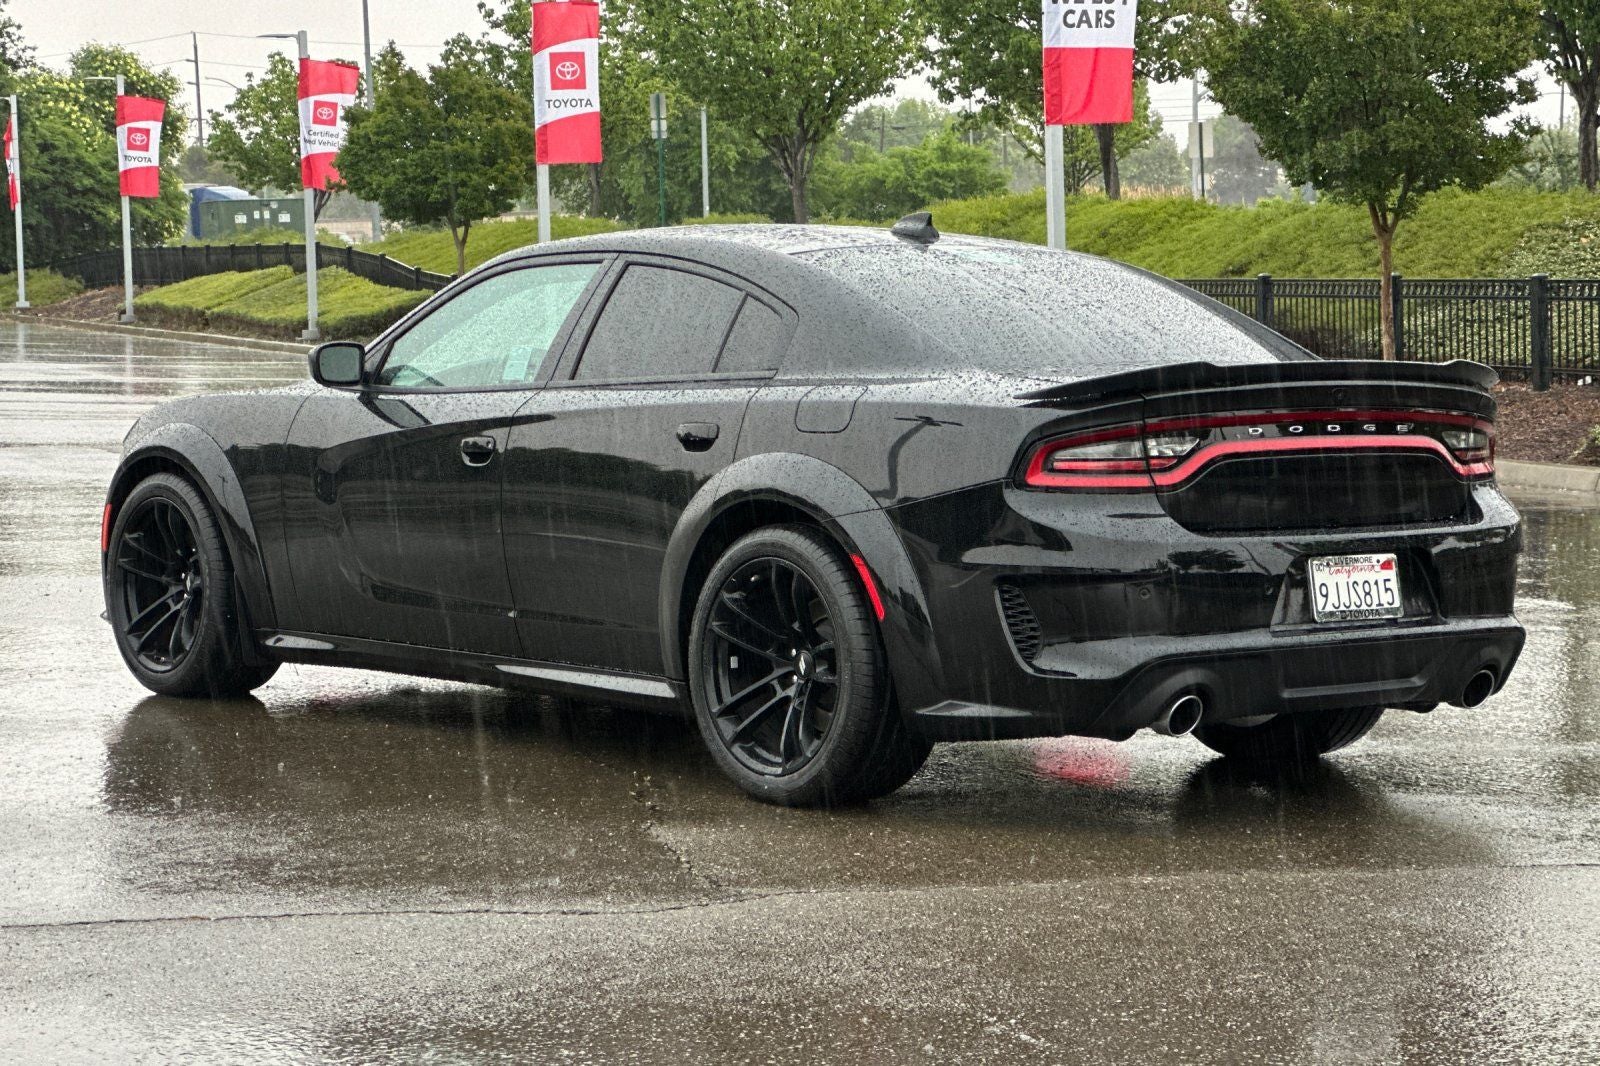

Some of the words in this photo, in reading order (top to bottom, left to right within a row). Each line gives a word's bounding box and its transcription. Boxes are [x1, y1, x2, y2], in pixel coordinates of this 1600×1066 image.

[1062, 9, 1116, 29] CARS
[545, 98, 593, 109] TOYOTA
[307, 129, 340, 139] Certified
[123, 154, 153, 163] TOYOTA
[1248, 424, 1410, 435] DODGE
[1334, 556, 1374, 566] LIVERMORE
[1328, 564, 1377, 579] California
[1319, 578, 1396, 611] 9JJS815
[1349, 609, 1381, 619] TOYOTA
